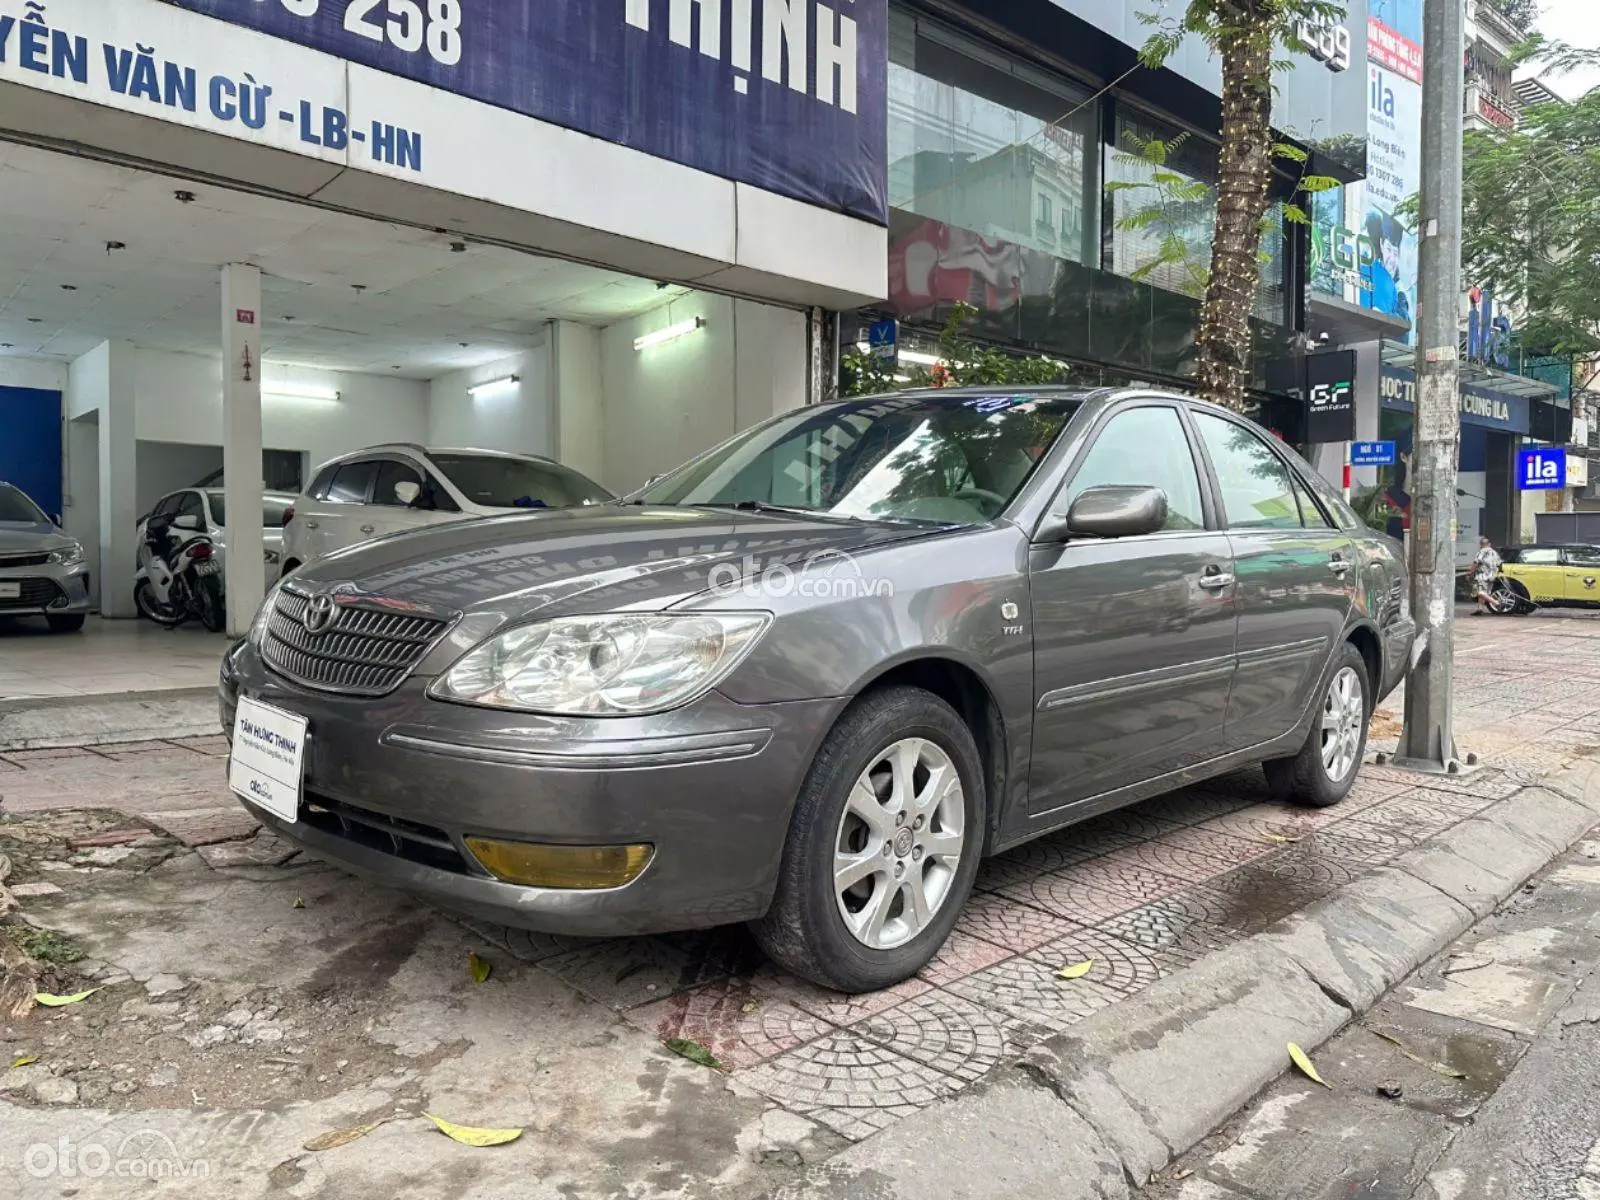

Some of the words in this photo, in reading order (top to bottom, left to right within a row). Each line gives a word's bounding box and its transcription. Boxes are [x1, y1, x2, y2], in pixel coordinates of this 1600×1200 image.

[103, 43, 196, 112] VĂN
[209, 72, 272, 129] CỪ
[1371, 69, 1394, 118] ila
[1464, 391, 1492, 417] CÙNG
[1493, 401, 1509, 420] ILA
[1527, 455, 1557, 479] ila
